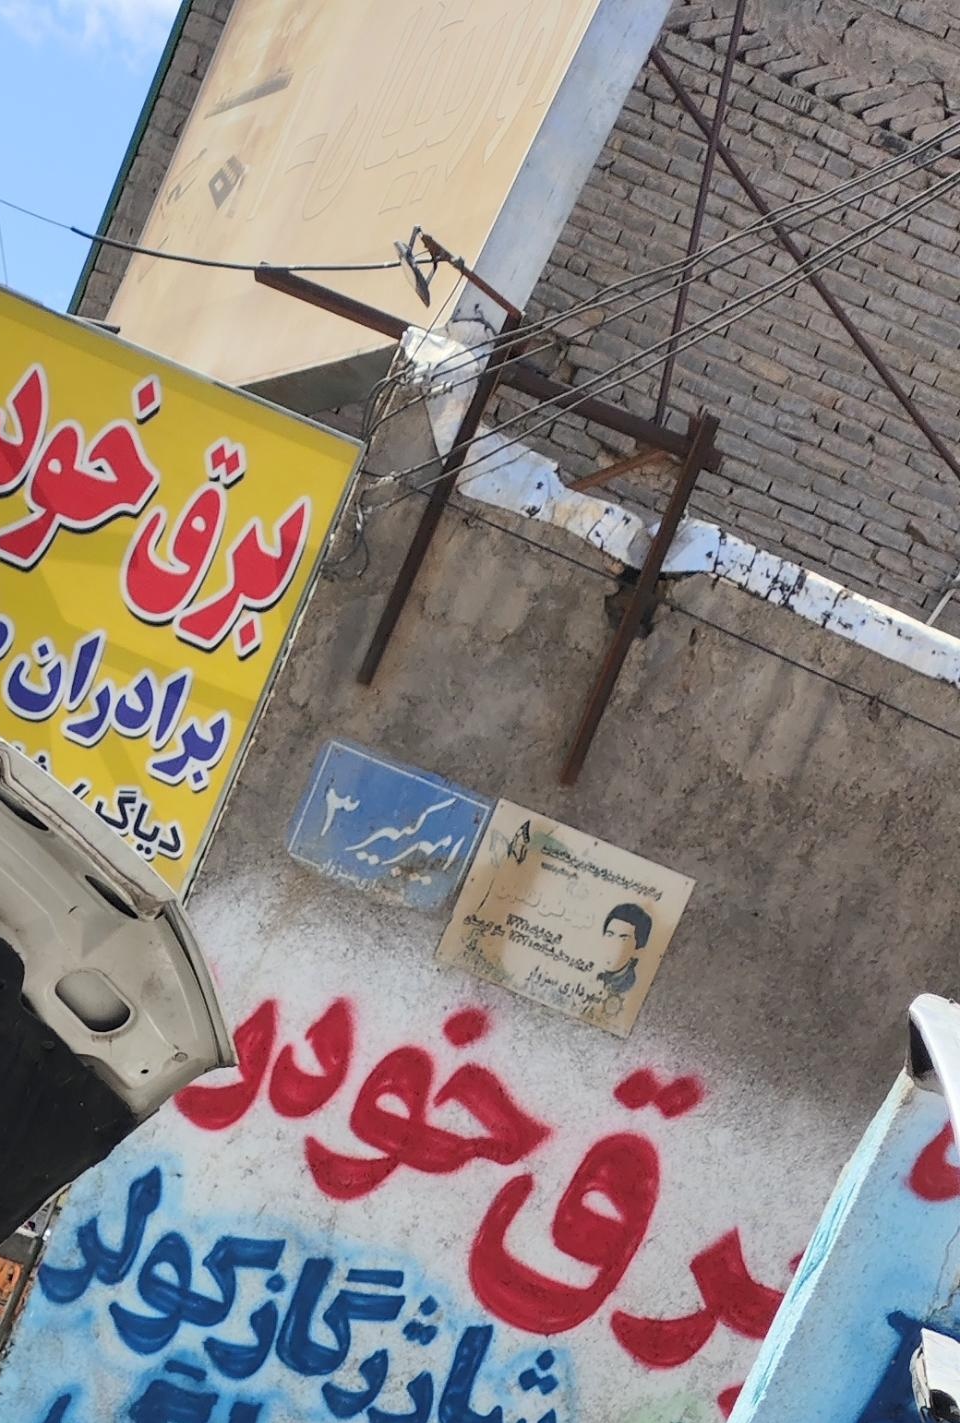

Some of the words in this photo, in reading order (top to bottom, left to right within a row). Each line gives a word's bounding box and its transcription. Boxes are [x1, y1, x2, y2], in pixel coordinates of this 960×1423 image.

[124, 438, 309, 658] برق
[5, 632, 228, 786] برادران
[95, 791, 182, 855] دیاگ
[174, 998, 553, 1201] خودر
[39, 1165, 286, 1355] کولر
[203, 1256, 406, 1379] گاز
